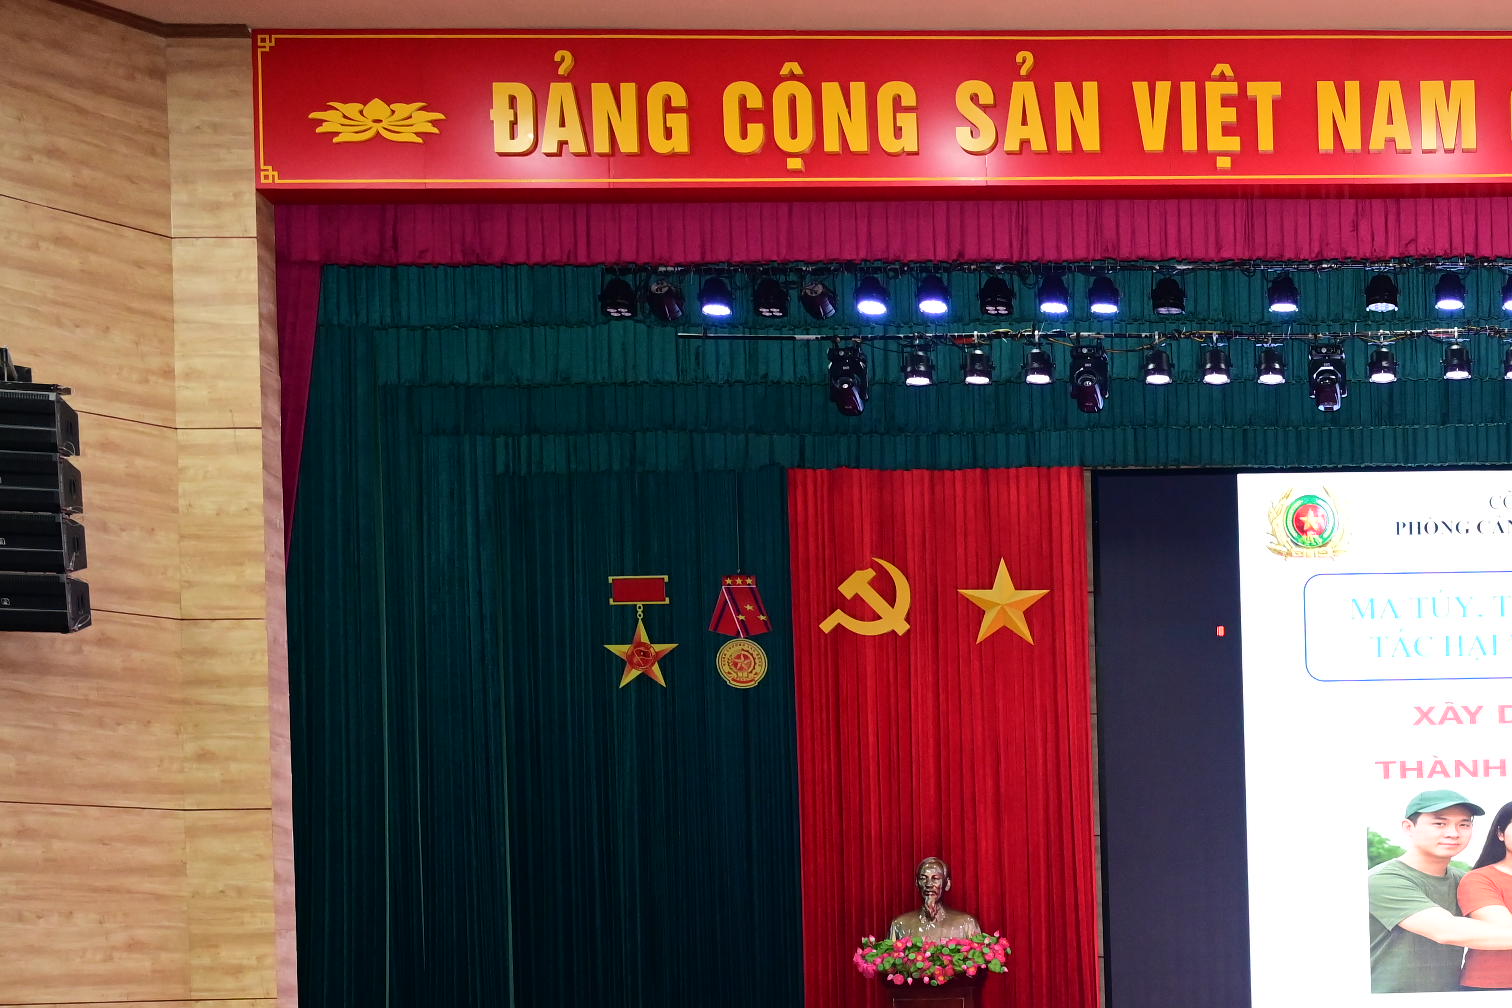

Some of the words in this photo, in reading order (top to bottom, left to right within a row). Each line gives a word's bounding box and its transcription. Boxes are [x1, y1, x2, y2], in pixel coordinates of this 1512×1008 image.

[490, 50, 690, 156] ĐẢNG
[723, 61, 918, 170] CỘNG
[955, 51, 1100, 155] SẢN
[1132, 63, 1281, 169] VIỆT
[1317, 80, 1476, 153] NAM
[1351, 597, 1400, 619] MA
[1413, 701, 1484, 725] XÂY
[1375, 755, 1507, 779] THÀNH
